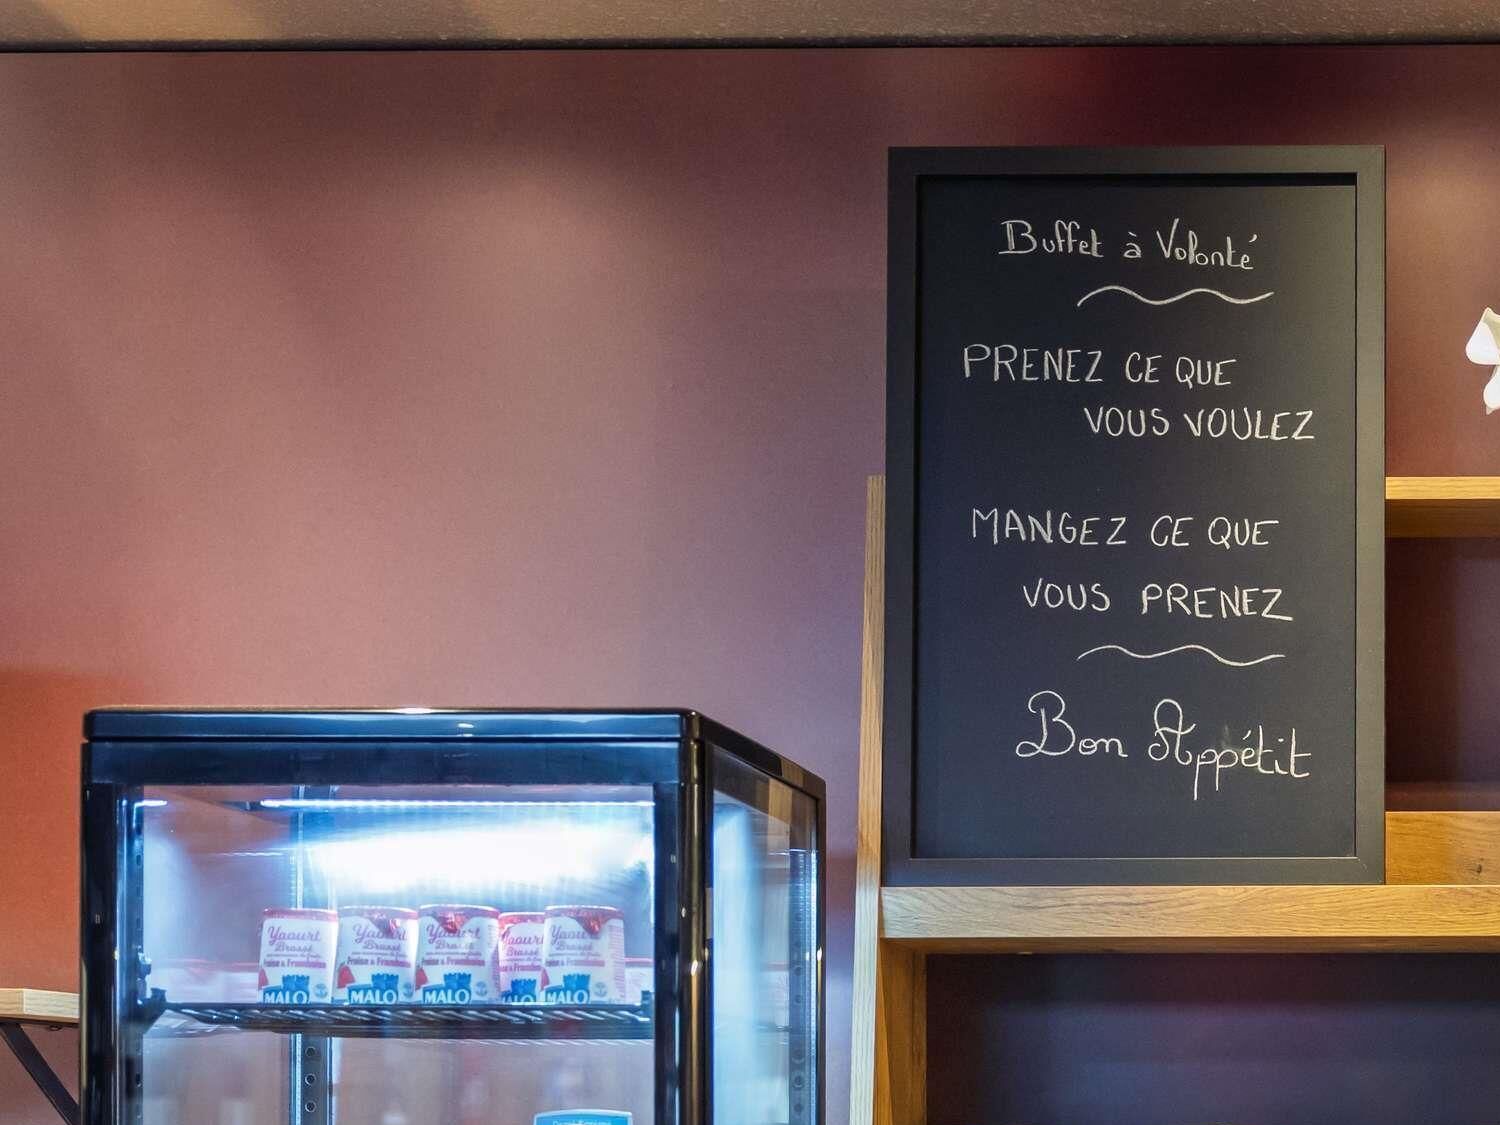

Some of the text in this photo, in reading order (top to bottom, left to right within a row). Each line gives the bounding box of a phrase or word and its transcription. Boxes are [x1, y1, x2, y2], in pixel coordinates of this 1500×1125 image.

[998, 217, 1258, 270] Buffet à Volonté
[963, 343, 1237, 390] PRENEZ CE QUE
[1083, 406, 1315, 441] VOUS VOULEZ
[972, 507, 1280, 550] MANGEZ CE QUE
[1022, 577, 1294, 622] VOUS PRENEZ
[1015, 689, 1312, 801] Bon Appétit
[350, 989, 397, 1004] MALO
[424, 989, 470, 1004] MALO
